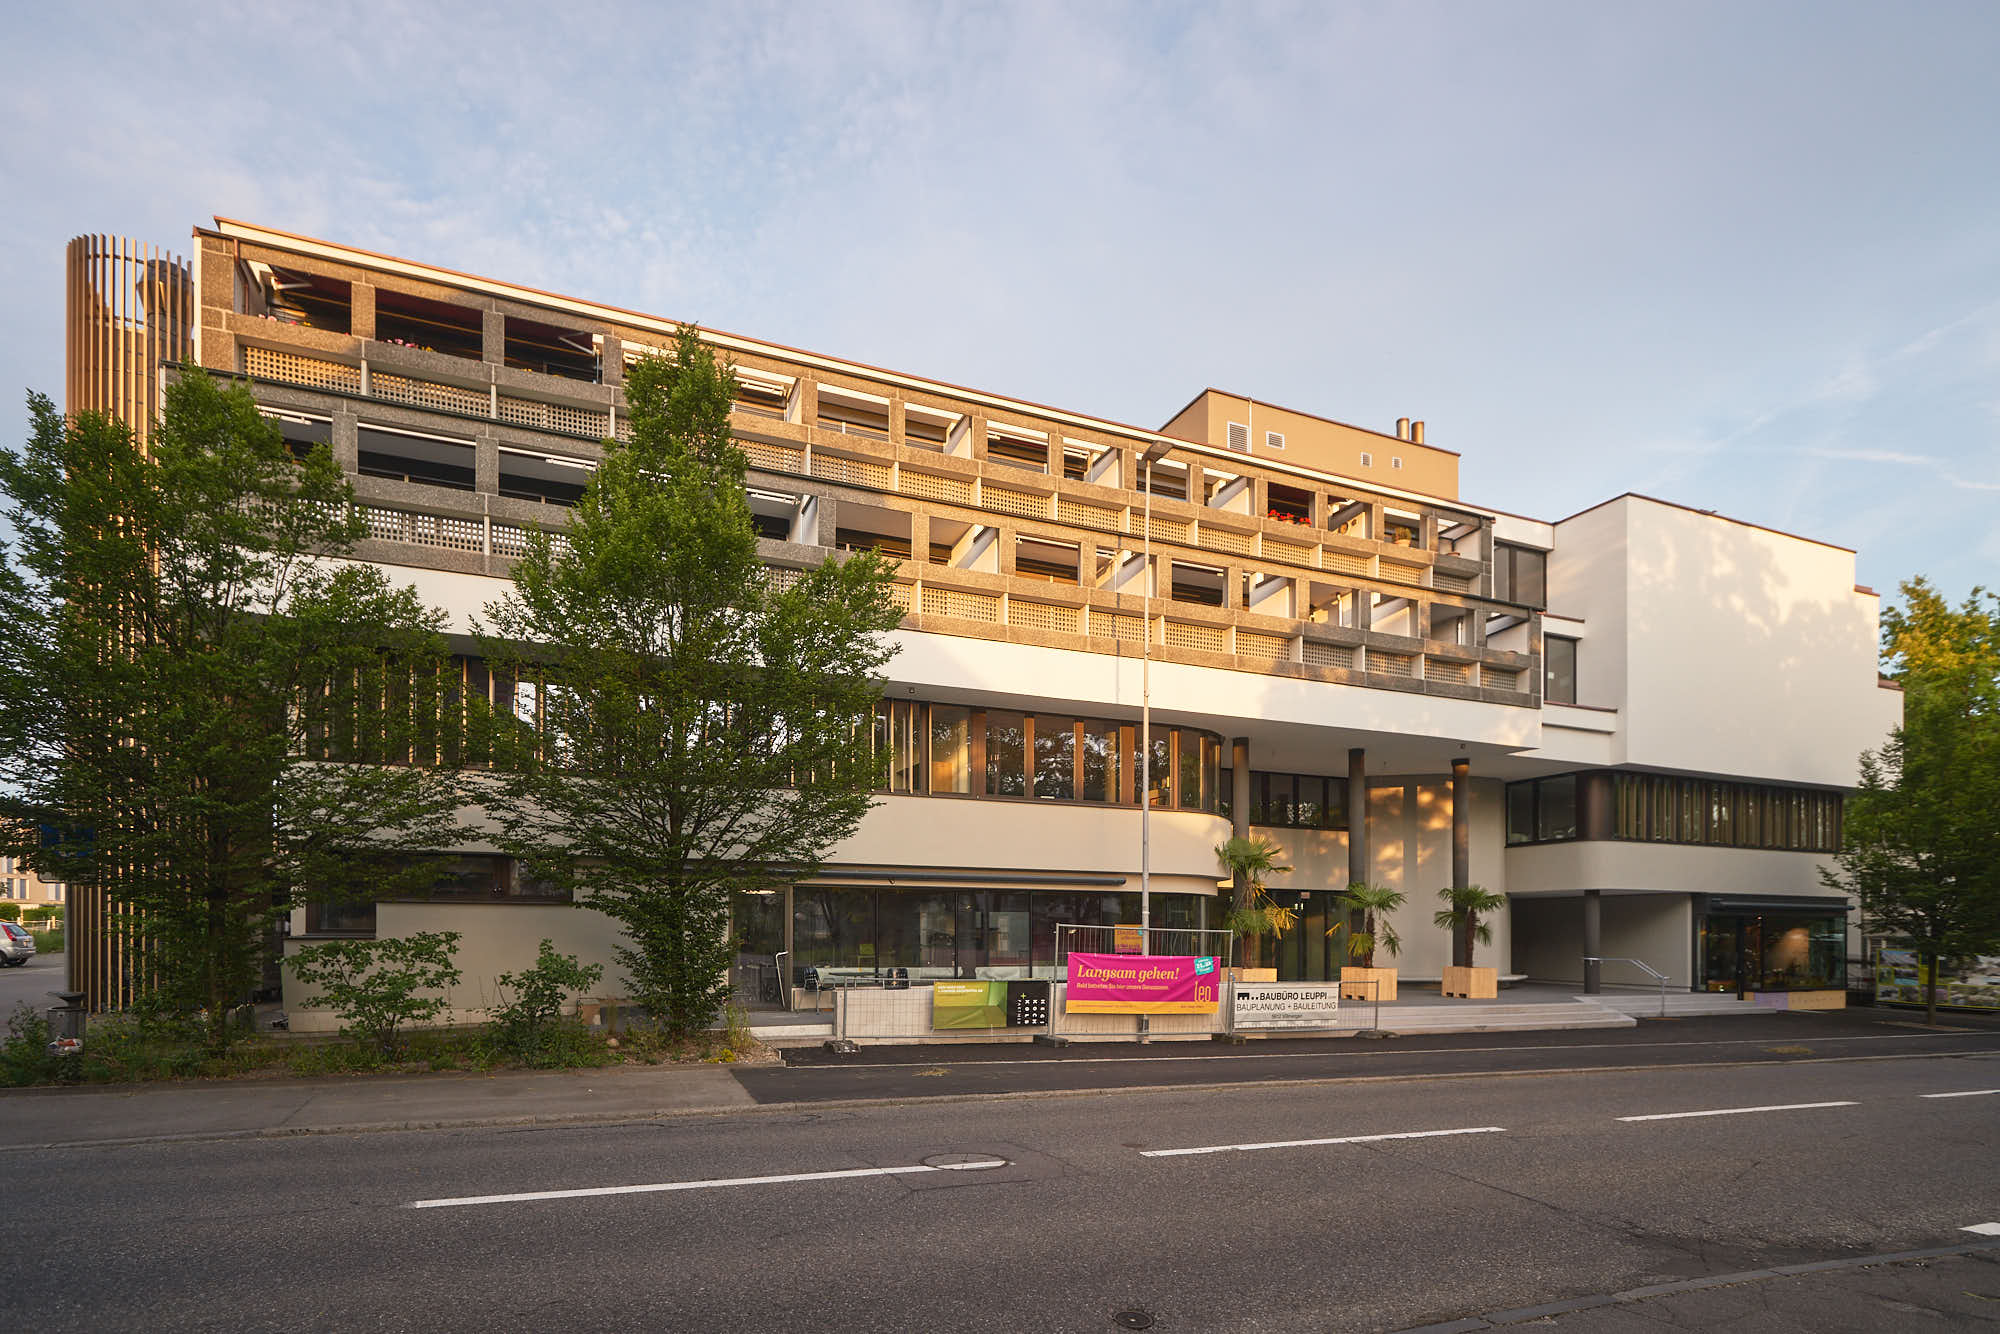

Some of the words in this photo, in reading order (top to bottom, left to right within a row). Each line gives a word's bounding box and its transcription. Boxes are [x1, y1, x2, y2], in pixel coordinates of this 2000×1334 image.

[1077, 964, 1136, 982] Langsam
[1138, 966, 1180, 982] gehen!
[1194, 981, 1211, 1002] leo
[1260, 991, 1298, 1000] BAUBÜRO
[1300, 992, 1327, 1000] LEUPPI
[1236, 1003, 1285, 1011] BAUPLANUNG
[1293, 1002, 1336, 1010] BAULEITUNG
